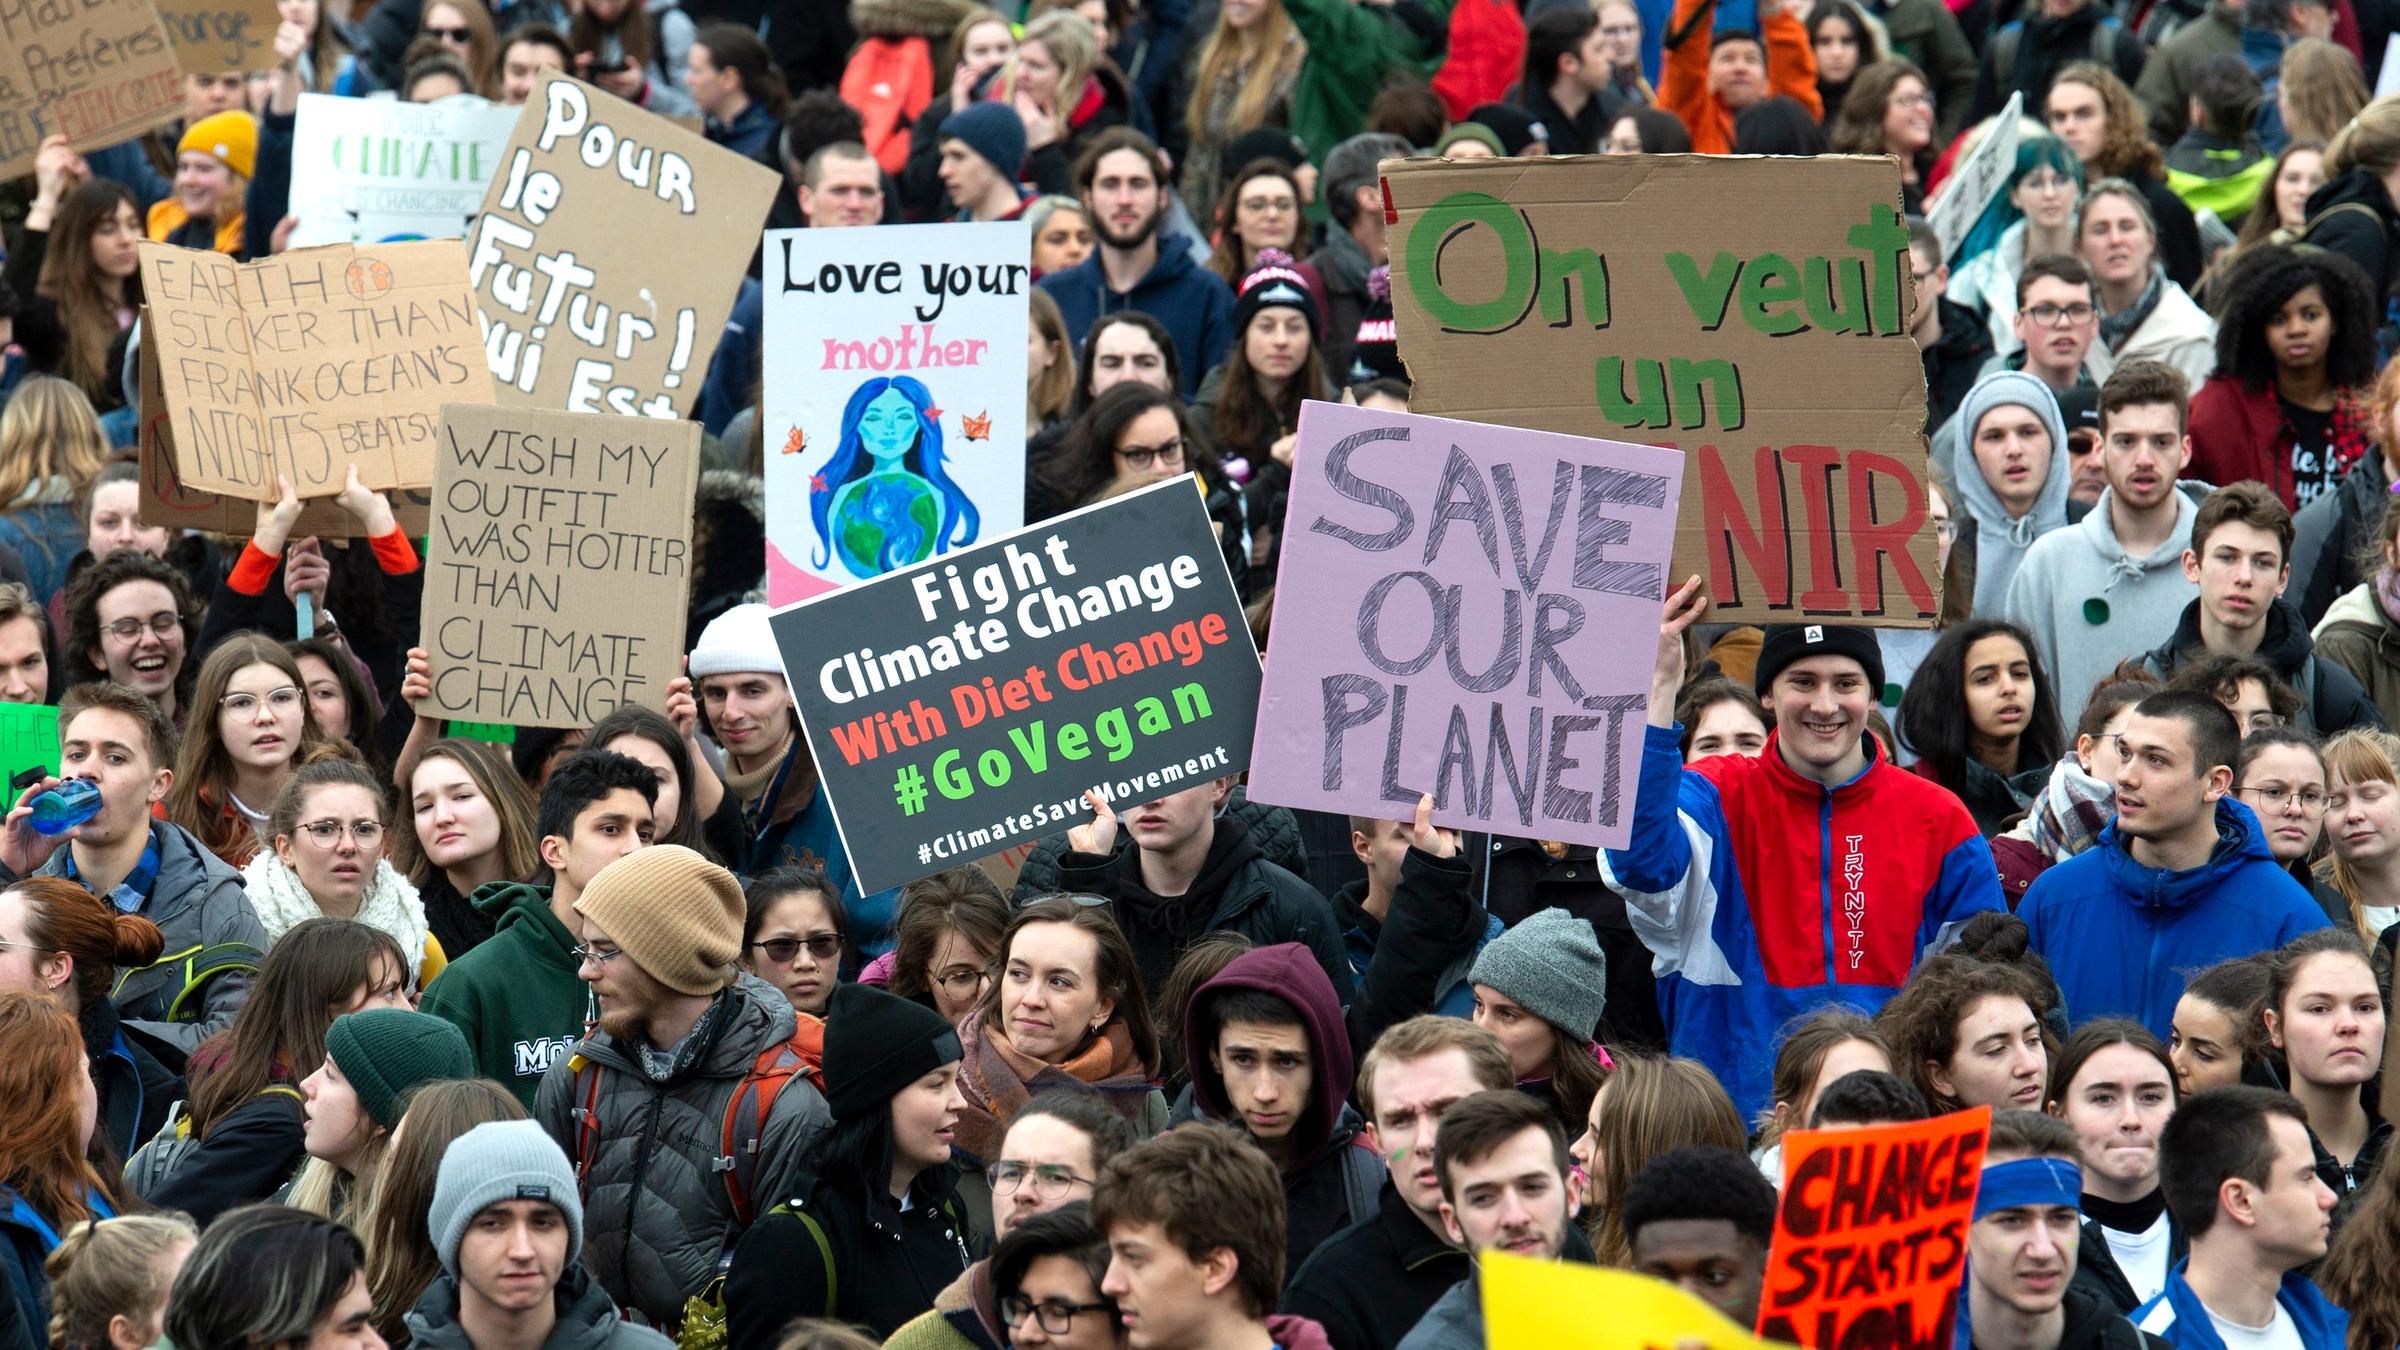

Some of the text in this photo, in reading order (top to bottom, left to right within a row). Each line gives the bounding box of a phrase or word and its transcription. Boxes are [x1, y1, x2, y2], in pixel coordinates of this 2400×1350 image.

[499, 146, 562, 226] le
[155, 259, 328, 312] EARTH
[781, 237, 1027, 322] Love your
[1405, 190, 1612, 336] On
[1664, 203, 1912, 338] veut
[169, 292, 474, 355] SICKER THAN
[820, 323, 988, 371] mother
[179, 344, 469, 409] FRANK OCEAN'S
[1594, 354, 1746, 433] un
[187, 406, 332, 488] NIGHTS
[447, 423, 669, 488] WISH MY
[447, 479, 618, 528] OUTFIT
[1310, 427, 1671, 601] SAVE
[441, 514, 686, 577] WAS HOTTER
[442, 562, 560, 612] THAN
[911, 533, 1077, 622] Fight
[439, 616, 646, 678] CLIMATE
[819, 553, 1202, 704] Climate Change
[1357, 570, 1588, 704] OUR
[830, 611, 1229, 767] With Diet Change
[893, 680, 1213, 817] #GoVegan
[1321, 673, 1647, 829] PLANET
[1844, 834, 1865, 969] TRYNYTY
[1782, 1130, 1985, 1239] CHANGE
[1772, 1220, 1964, 1309] STARTS
